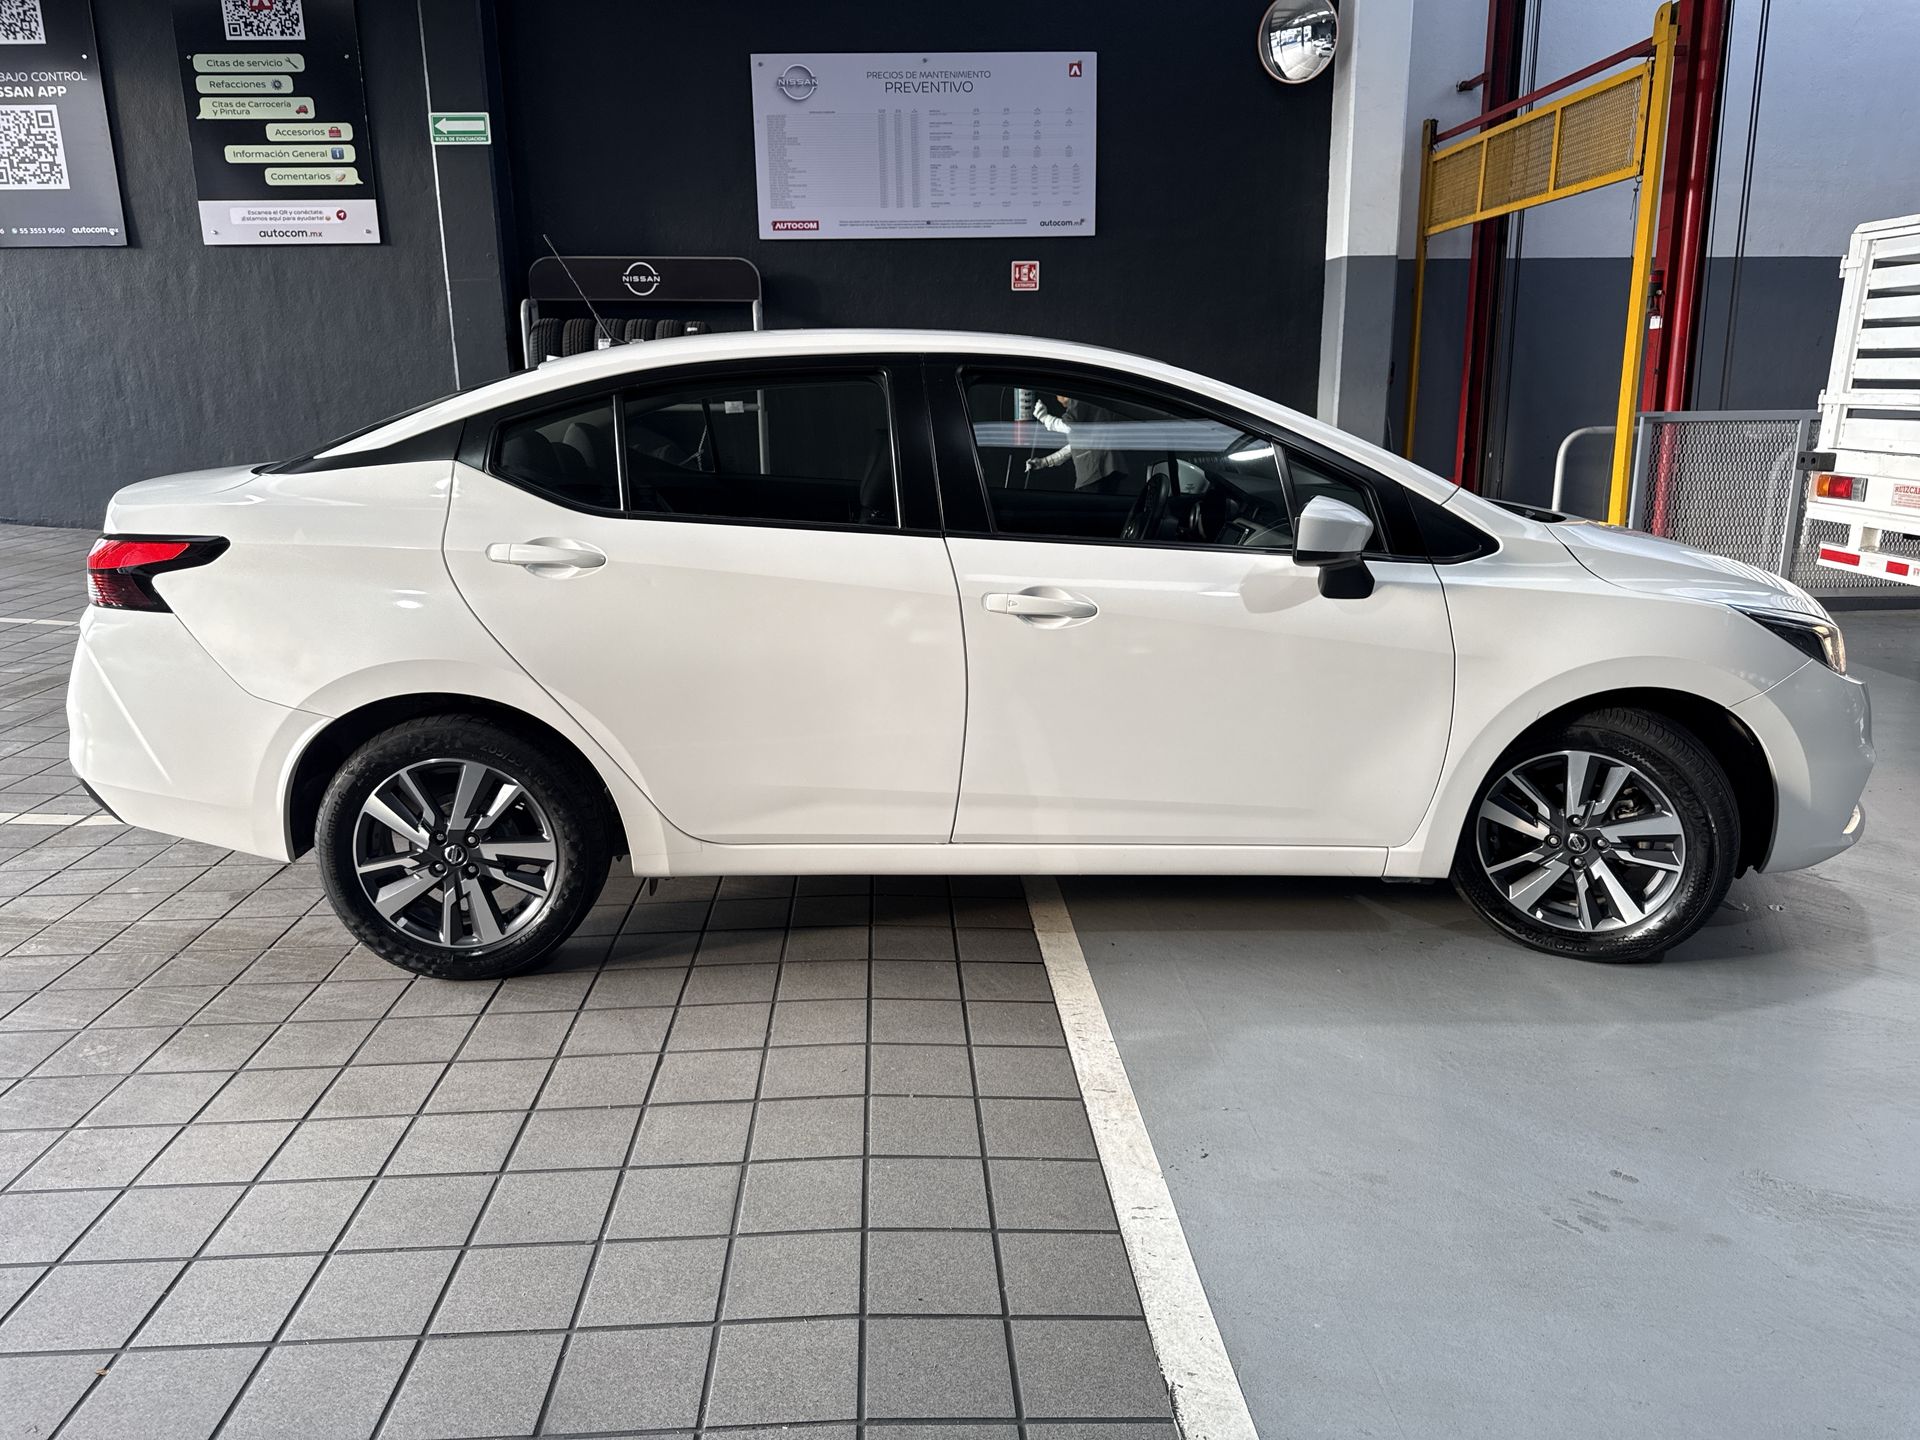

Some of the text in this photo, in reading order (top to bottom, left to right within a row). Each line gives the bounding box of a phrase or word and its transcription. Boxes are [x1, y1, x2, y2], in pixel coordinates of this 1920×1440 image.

[206, 59, 283, 67] Citas de servicio
[0, 71, 88, 82] BAJO CONTROL
[866, 70, 992, 80] PRECIOS DE MANTENIMIENTO
[209, 80, 267, 88] Refacciones
[777, 78, 819, 86] NISSAN
[884, 80, 974, 93] PREVENTIVO
[37, 85, 67, 97] APP
[247, 100, 292, 108] Carrocería
[274, 128, 326, 136] Accesorios
[233, 149, 328, 158] Información General
[270, 172, 332, 180] Comentarios
[774, 221, 818, 230] AUTOCOM
[19, 227, 29, 235] 55
[258, 229, 323, 238] autocom.mx
